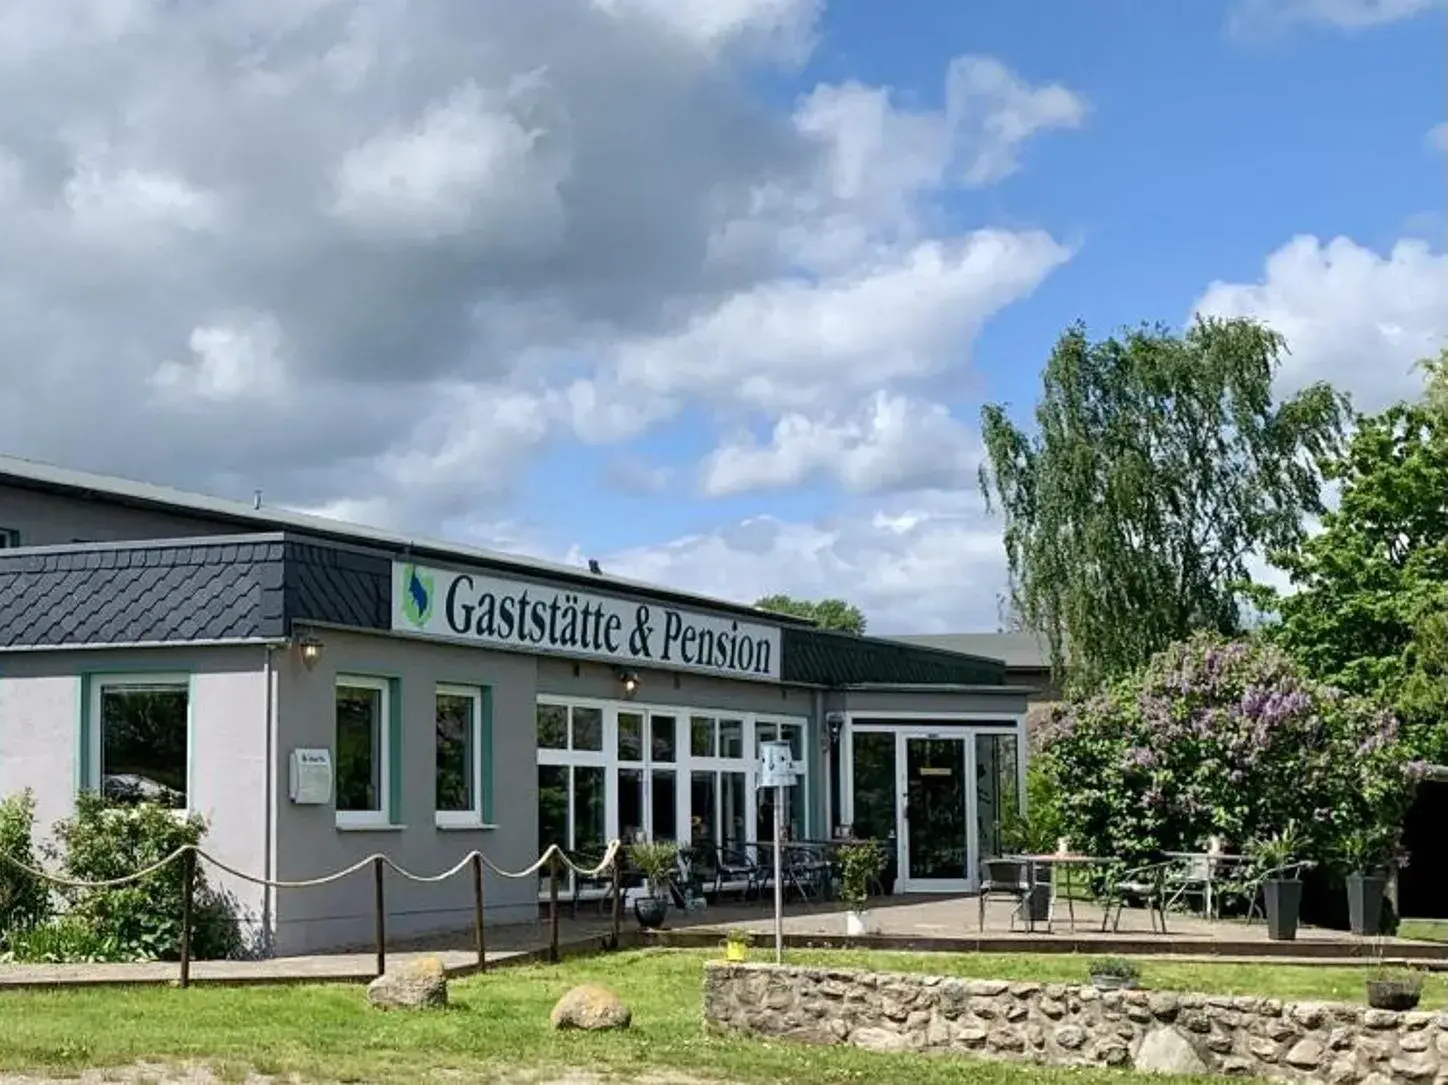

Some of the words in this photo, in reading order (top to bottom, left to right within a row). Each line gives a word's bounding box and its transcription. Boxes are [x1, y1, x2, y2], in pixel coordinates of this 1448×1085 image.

[445, 575, 622, 653] Gaststätte
[628, 605, 654, 657] &
[660, 610, 771, 674] Pension
